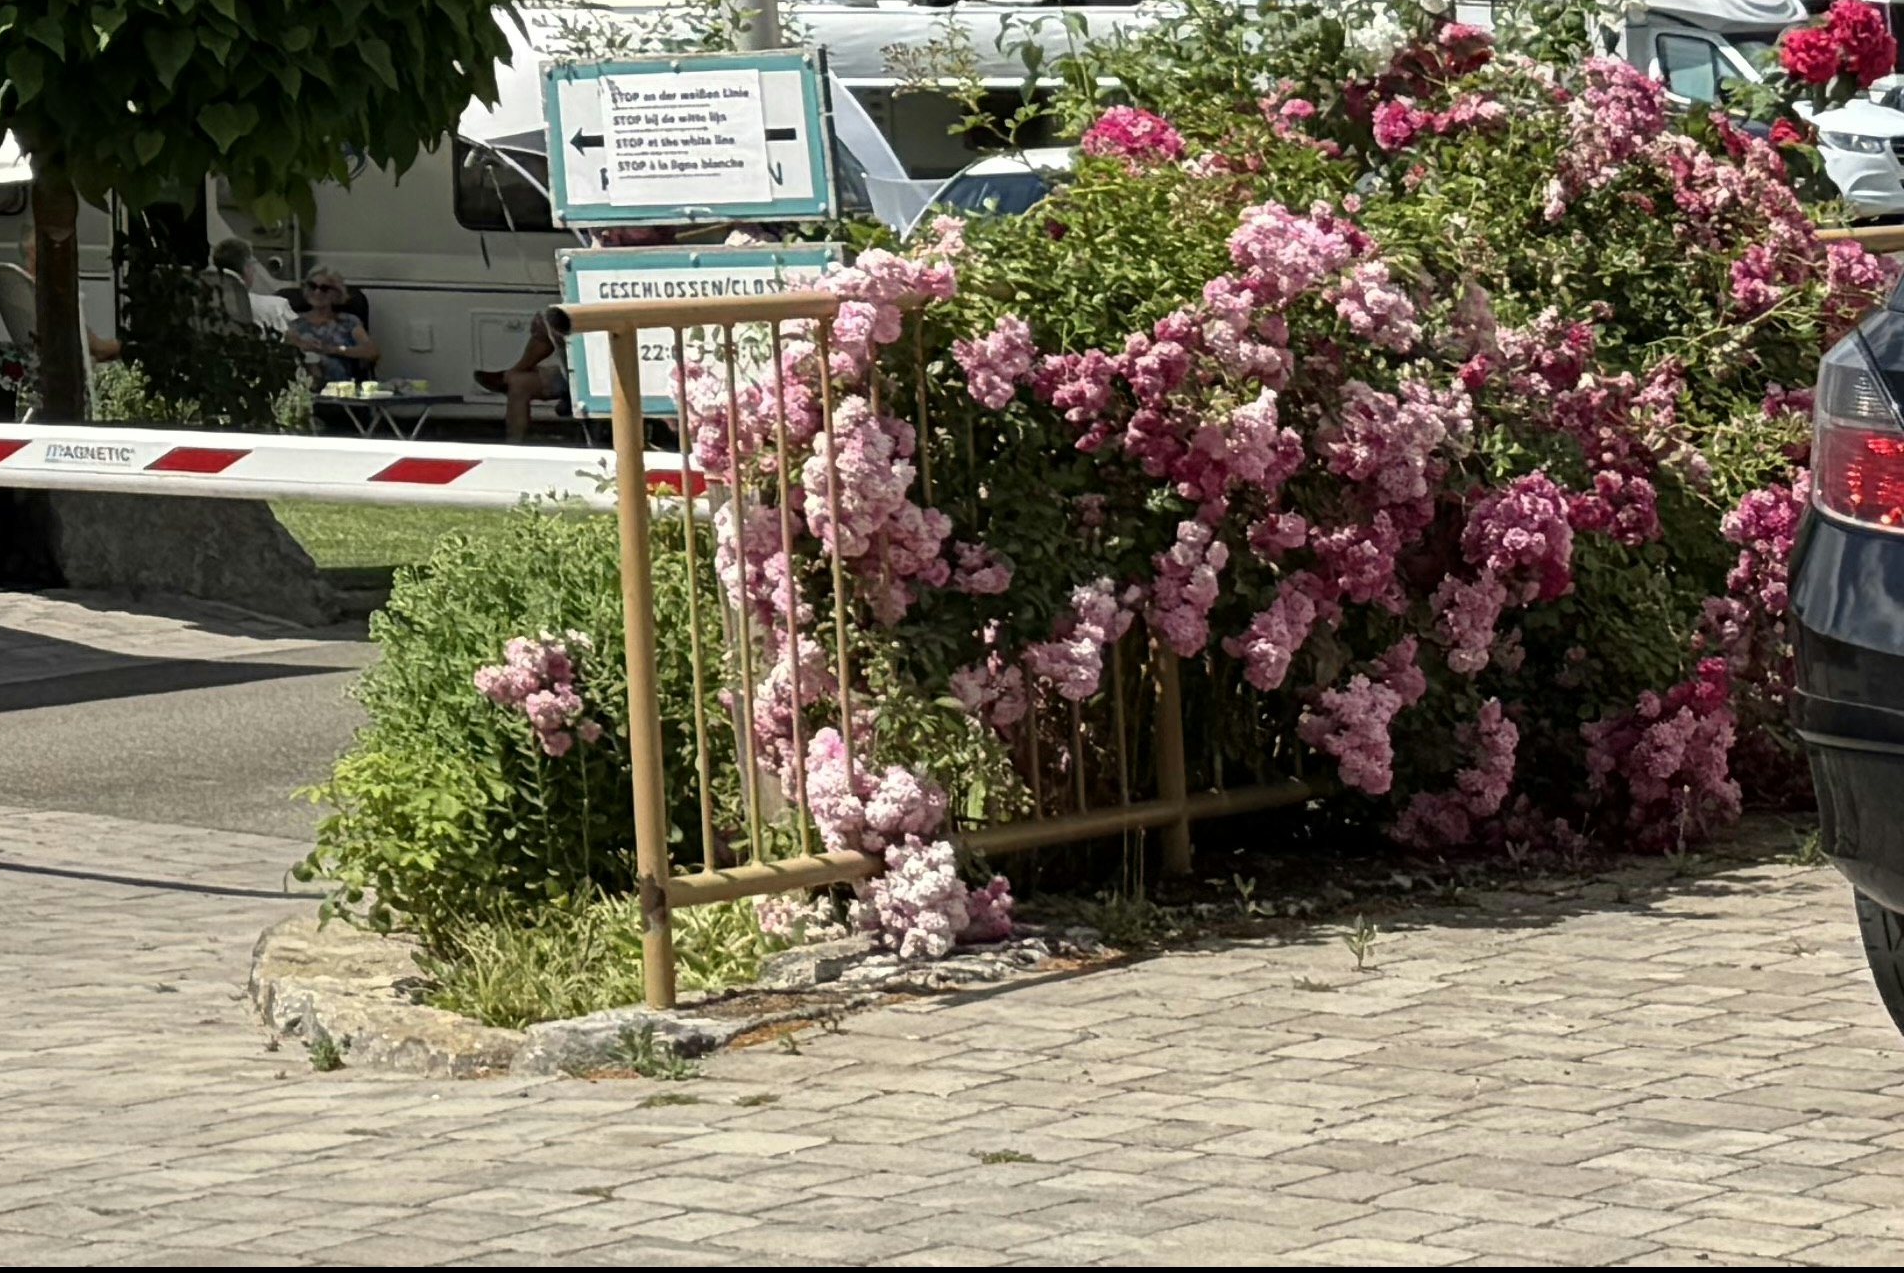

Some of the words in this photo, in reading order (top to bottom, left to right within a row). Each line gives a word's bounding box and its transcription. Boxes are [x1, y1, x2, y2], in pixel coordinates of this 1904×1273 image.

[612, 91, 640, 104] STOP
[613, 114, 642, 126] STOP
[616, 138, 644, 149] STOP
[680, 135, 712, 146] white
[714, 134, 736, 145] line
[617, 160, 647, 172] STOP
[701, 157, 745, 169] blanche
